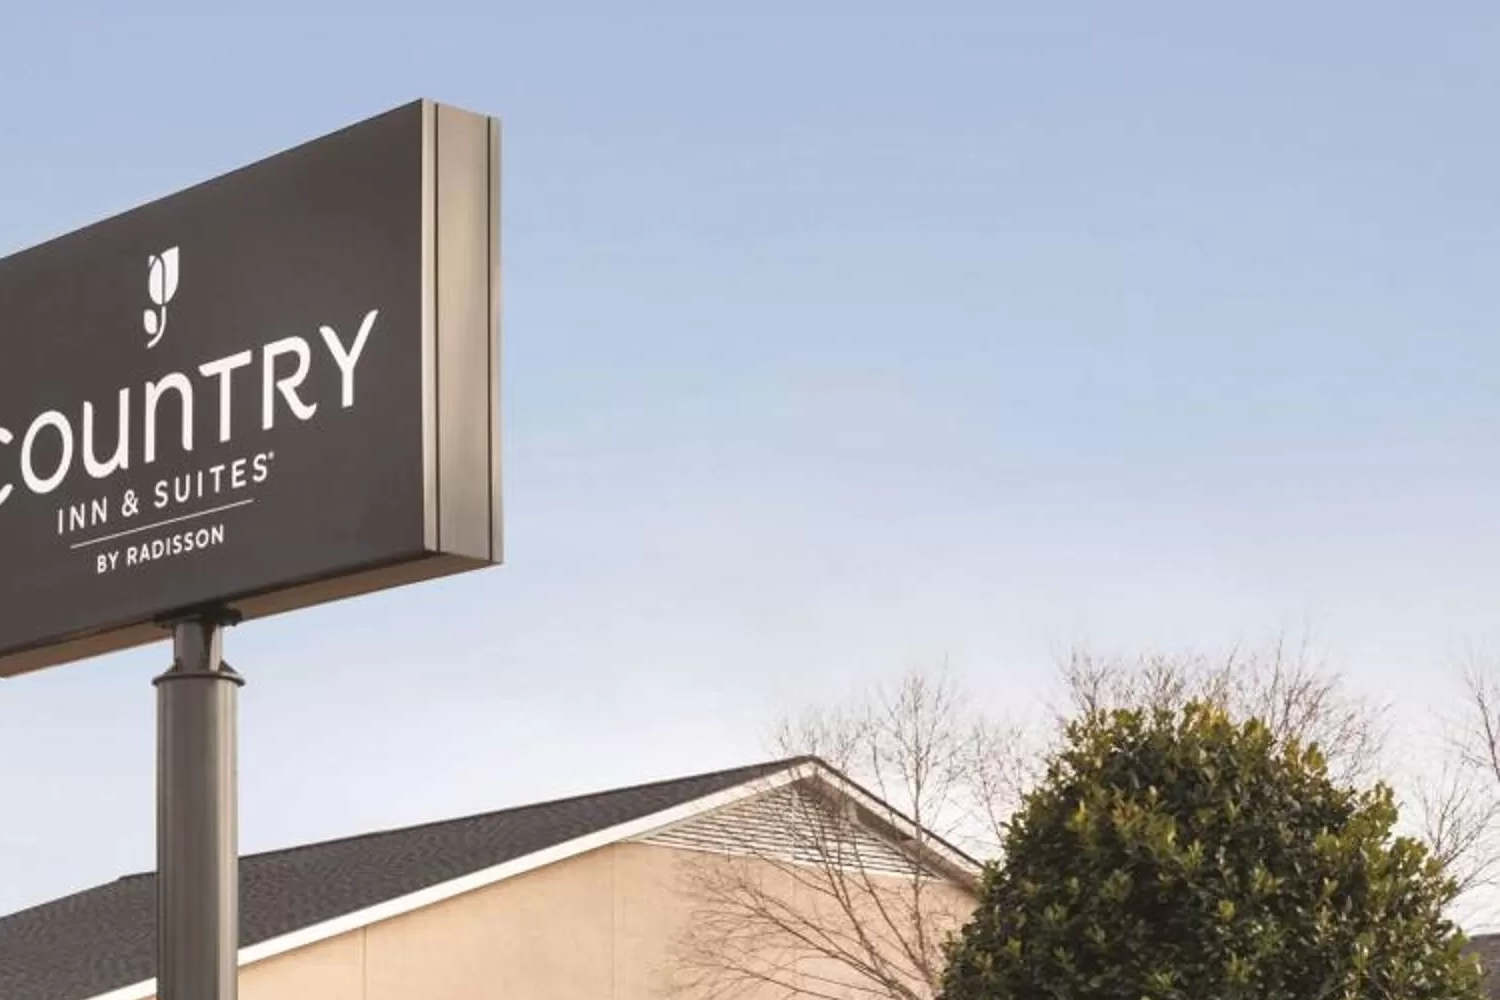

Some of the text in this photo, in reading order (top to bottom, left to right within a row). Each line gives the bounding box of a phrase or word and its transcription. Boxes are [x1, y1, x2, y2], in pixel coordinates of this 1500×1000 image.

[58, 496, 108, 535] INN
[121, 489, 139, 517] &
[97, 524, 224, 575] BY RADISSON
